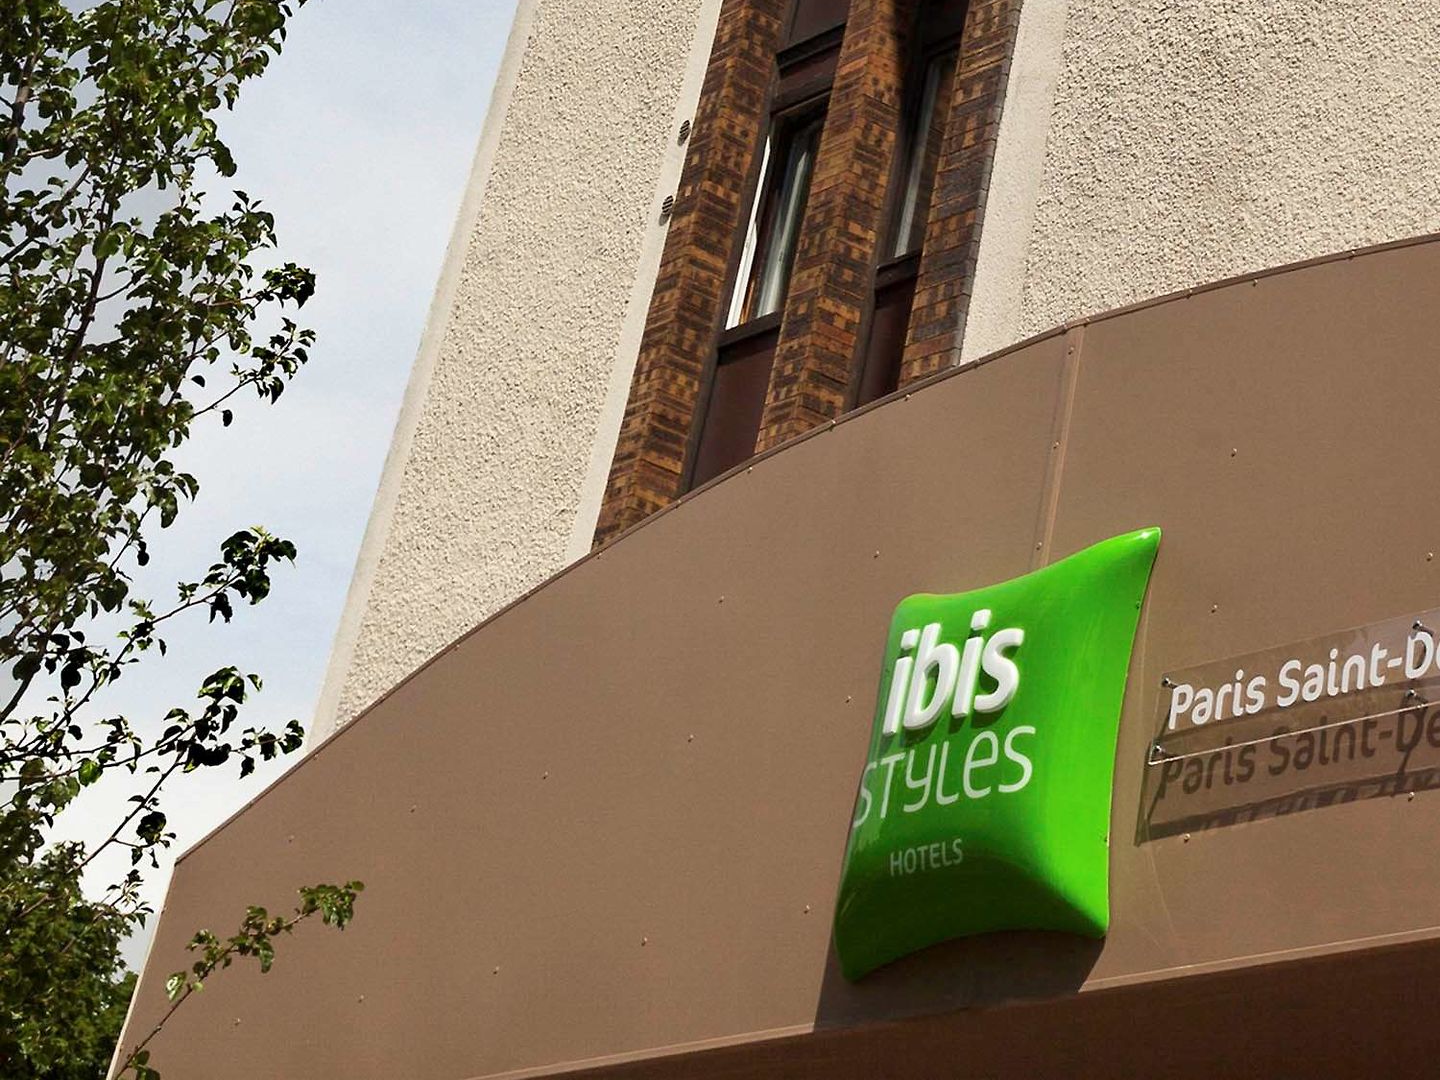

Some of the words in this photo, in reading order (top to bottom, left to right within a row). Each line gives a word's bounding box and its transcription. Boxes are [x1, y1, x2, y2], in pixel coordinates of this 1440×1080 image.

[882, 609, 1025, 736] ibis
[1167, 672, 1265, 730] Paris
[890, 838, 963, 877] HOTELS
